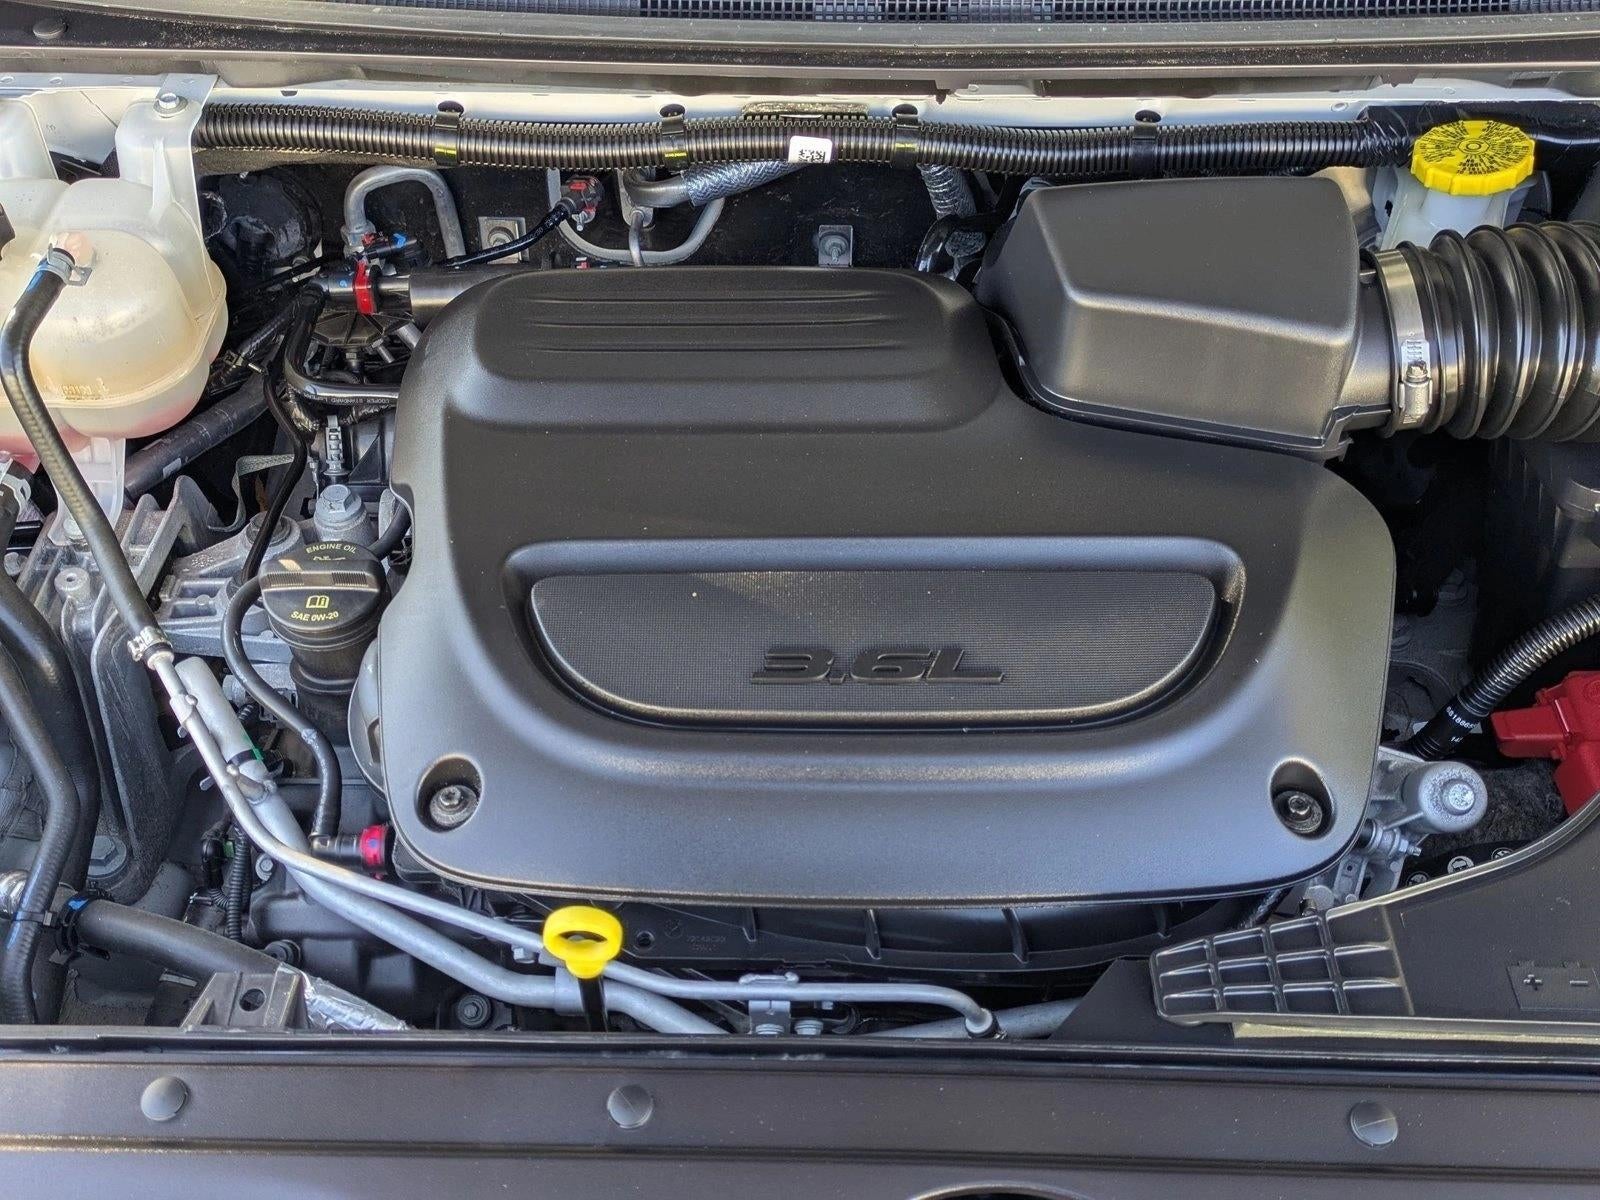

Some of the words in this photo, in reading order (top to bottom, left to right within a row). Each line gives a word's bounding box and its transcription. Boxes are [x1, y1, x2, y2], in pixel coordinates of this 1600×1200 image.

[305, 543, 342, 554] ENGINE
[343, 544, 358, 554] OIL
[290, 611, 309, 622] SAE
[310, 610, 339, 622] 0W-20
[751, 646, 1005, 685] 3.6L
